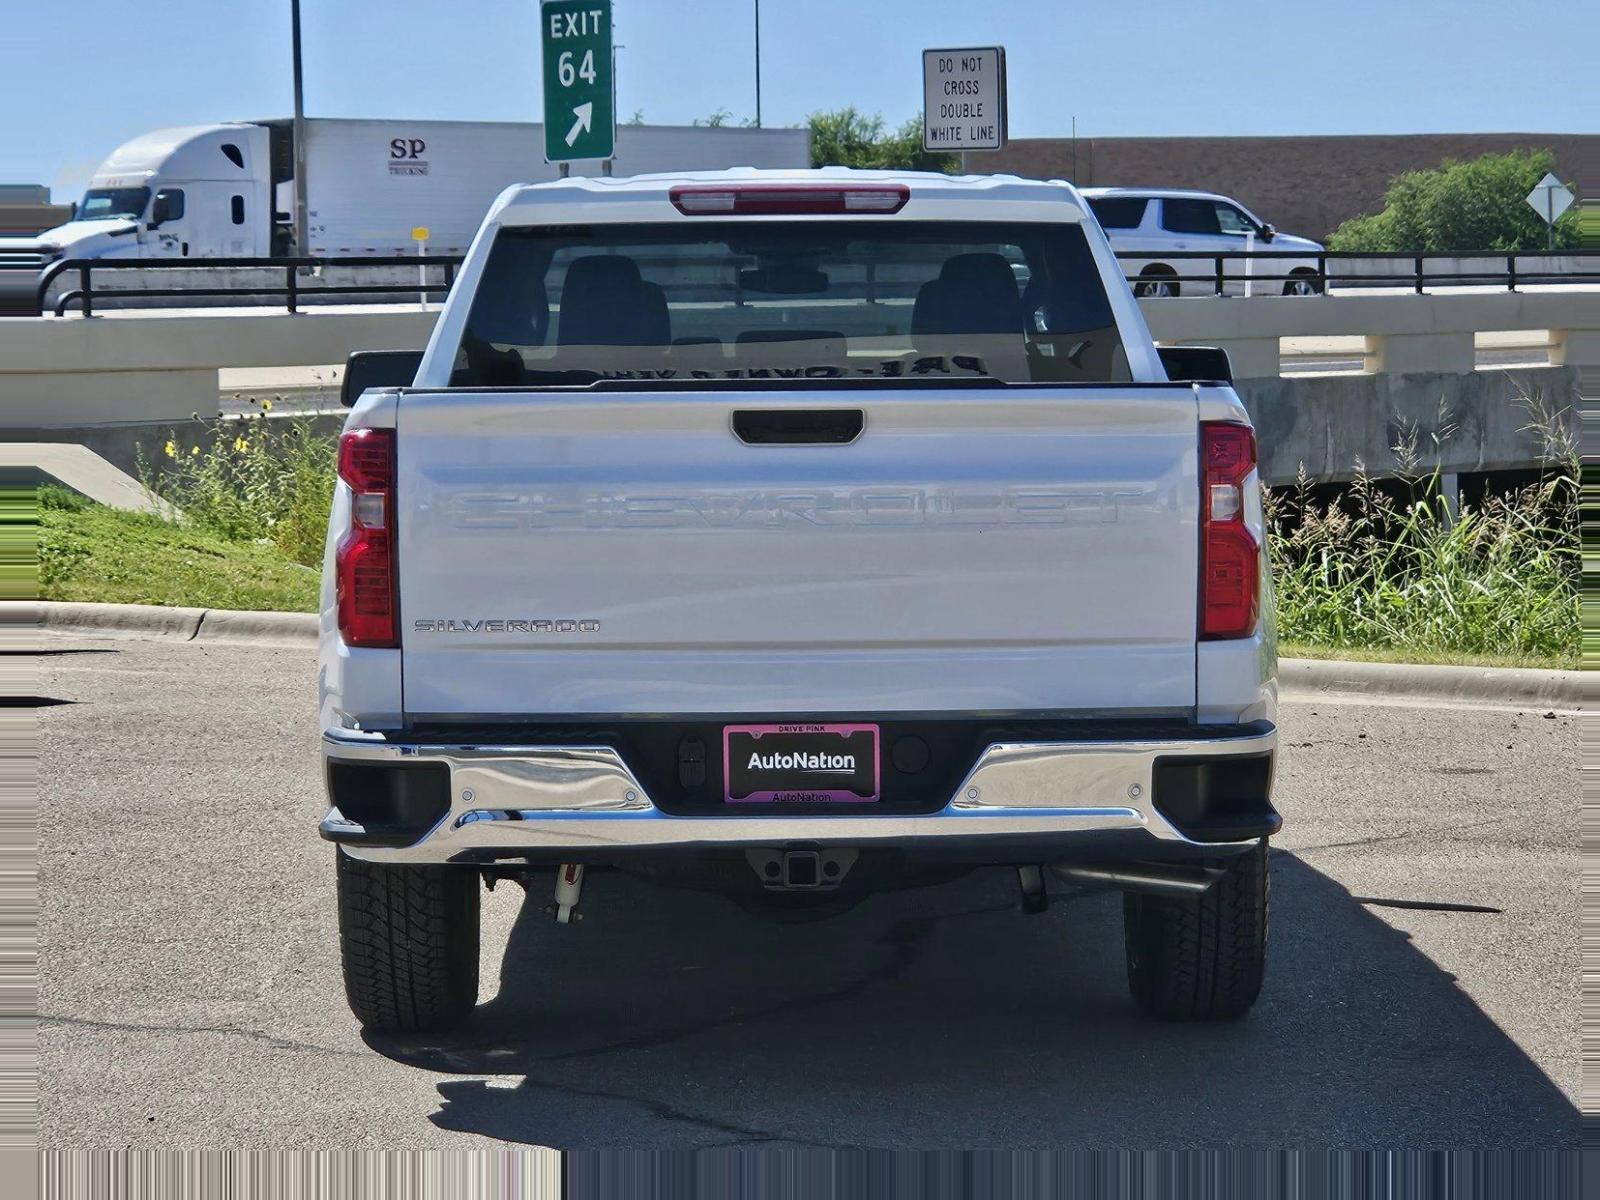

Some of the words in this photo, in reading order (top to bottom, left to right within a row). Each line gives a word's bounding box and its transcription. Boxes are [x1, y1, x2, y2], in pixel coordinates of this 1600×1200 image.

[550, 10, 602, 38] EXIT
[558, 49, 597, 87] 64
[938, 58, 953, 72] DO
[962, 57, 982, 72] NOT
[944, 80, 979, 95] CROSS
[940, 103, 983, 118] DOUBLE
[930, 126, 962, 141] WHITE
[970, 125, 995, 140] LINE
[390, 138, 426, 159] SP
[452, 485, 1150, 529] CHEVROLET
[414, 619, 601, 633] SILVERADO
[778, 725, 803, 733] DRIVE
[747, 751, 856, 770] AutoNation
[773, 792, 831, 803] AutoNation
